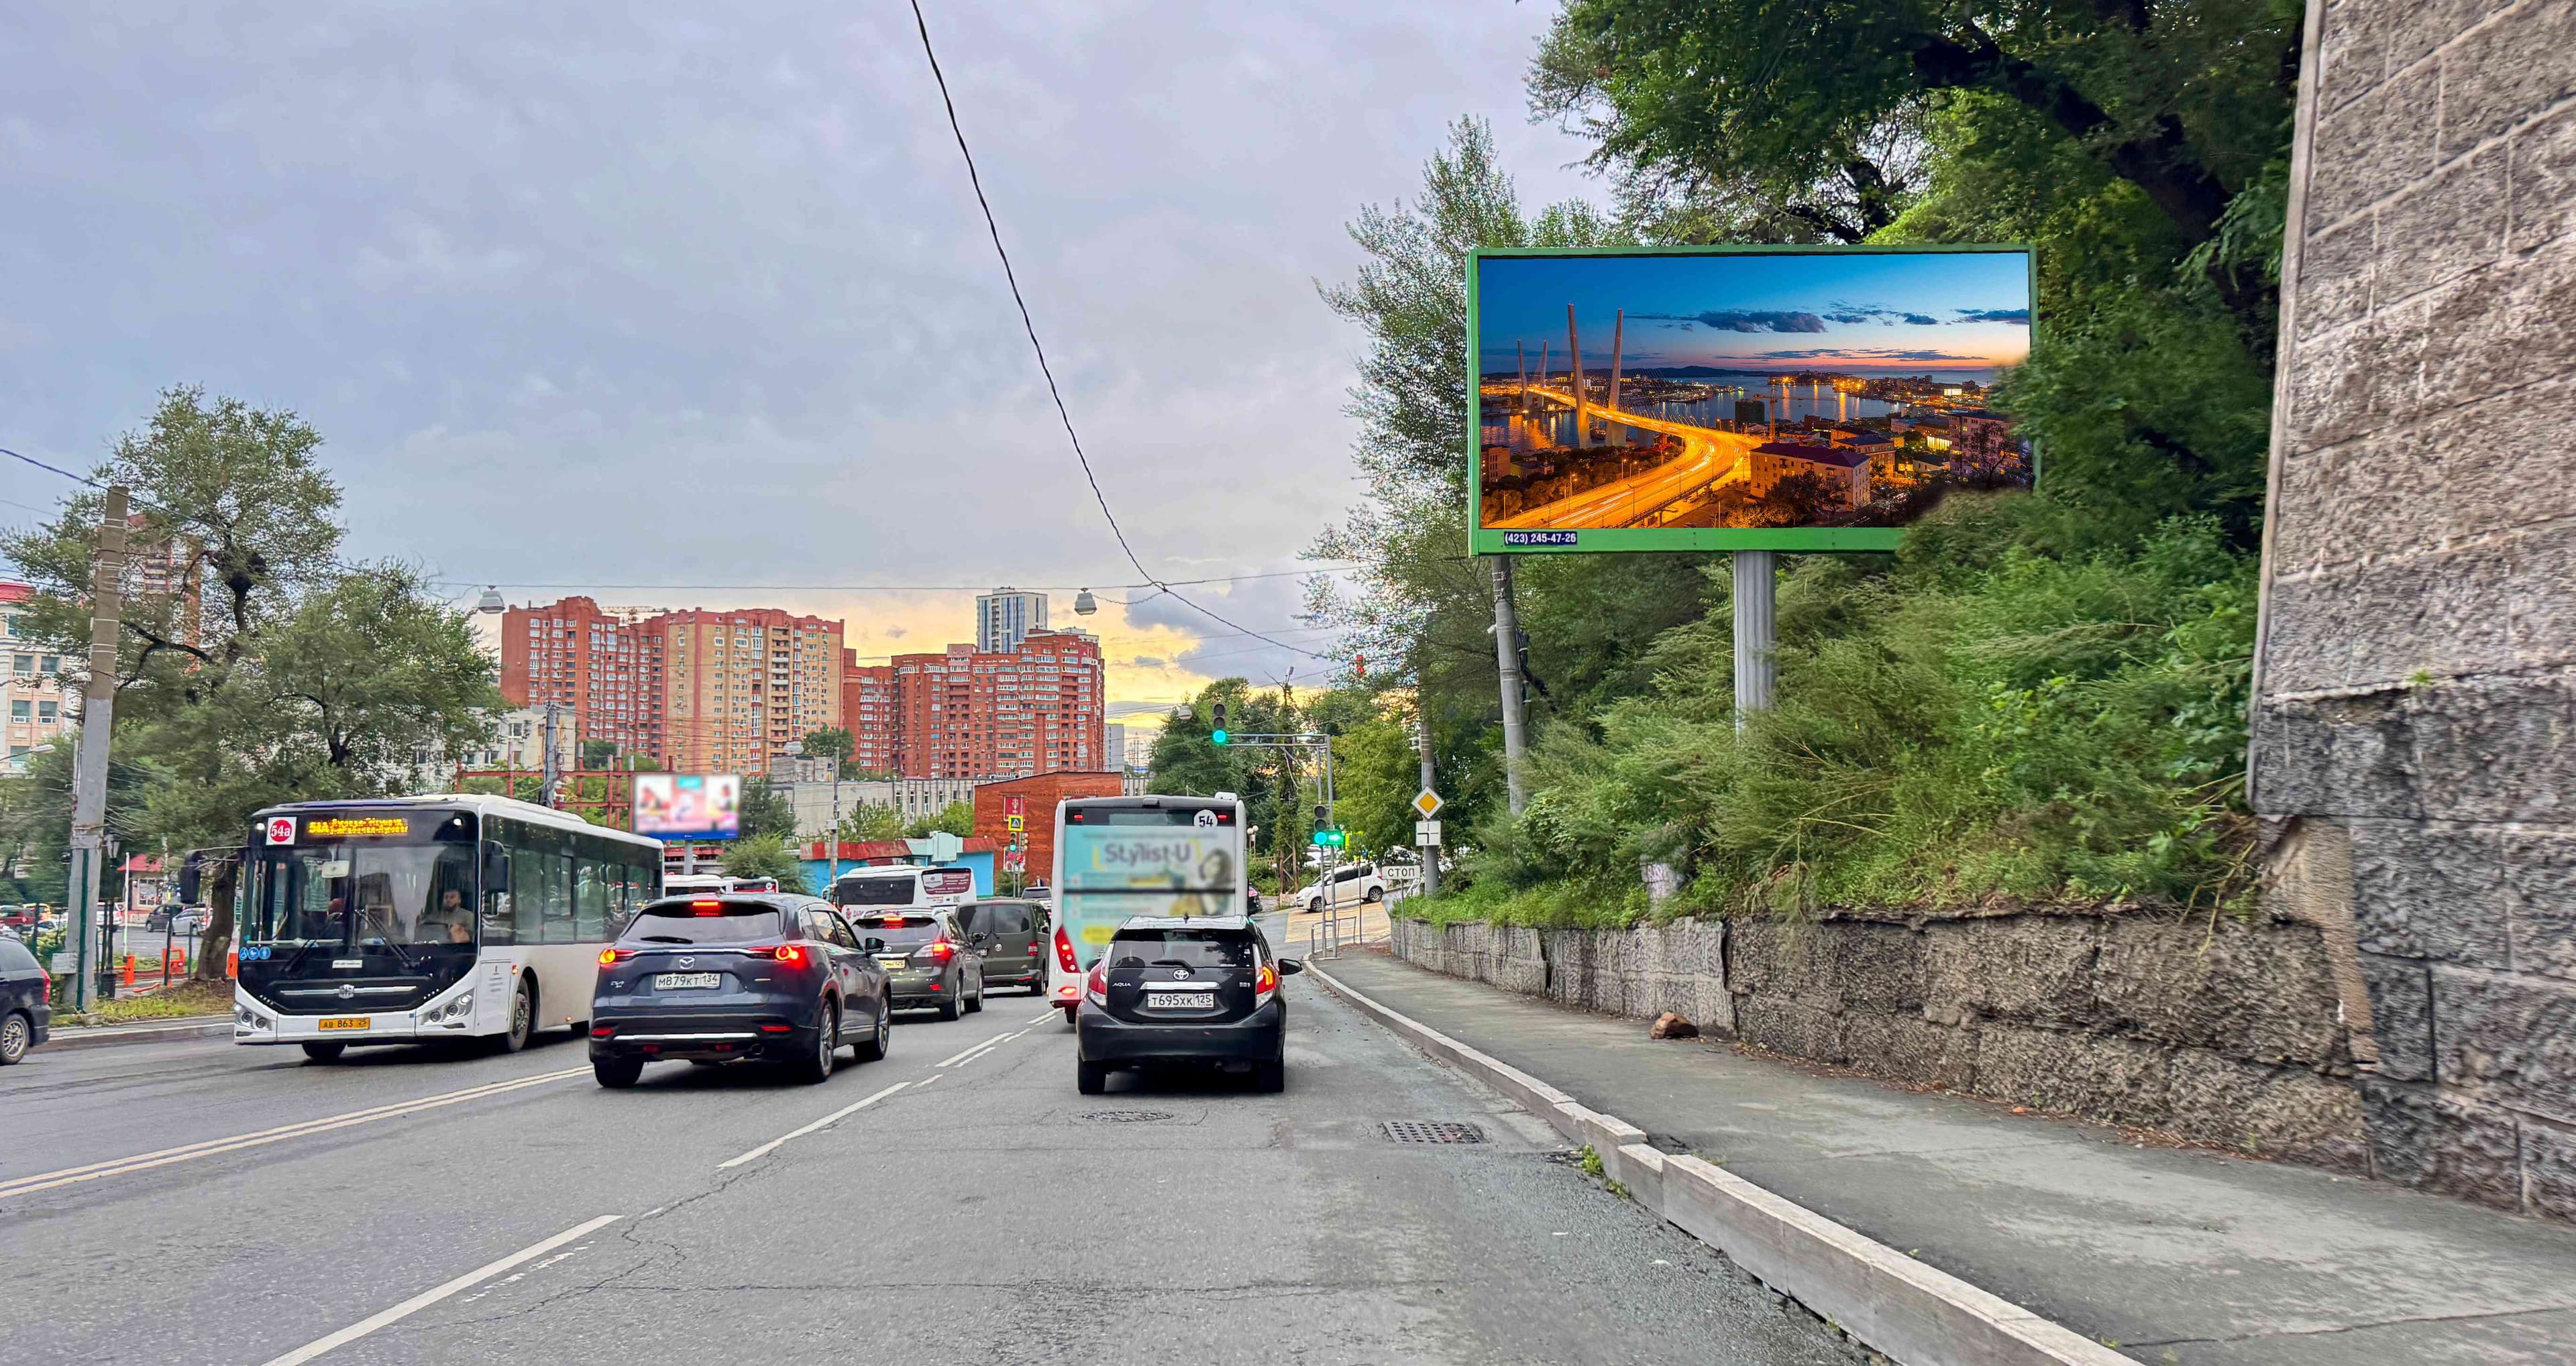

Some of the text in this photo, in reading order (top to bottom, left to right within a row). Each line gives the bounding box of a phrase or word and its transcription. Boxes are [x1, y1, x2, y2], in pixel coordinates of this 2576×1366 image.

[1505, 532, 1576, 545] (423) 245-47-26
[1199, 815, 1213, 828] 54
[1388, 868, 1415, 877] СТОП
[659, 974, 717, 986] М879КТ 134
[1152, 994, 1211, 1007] Т695ХК 125
